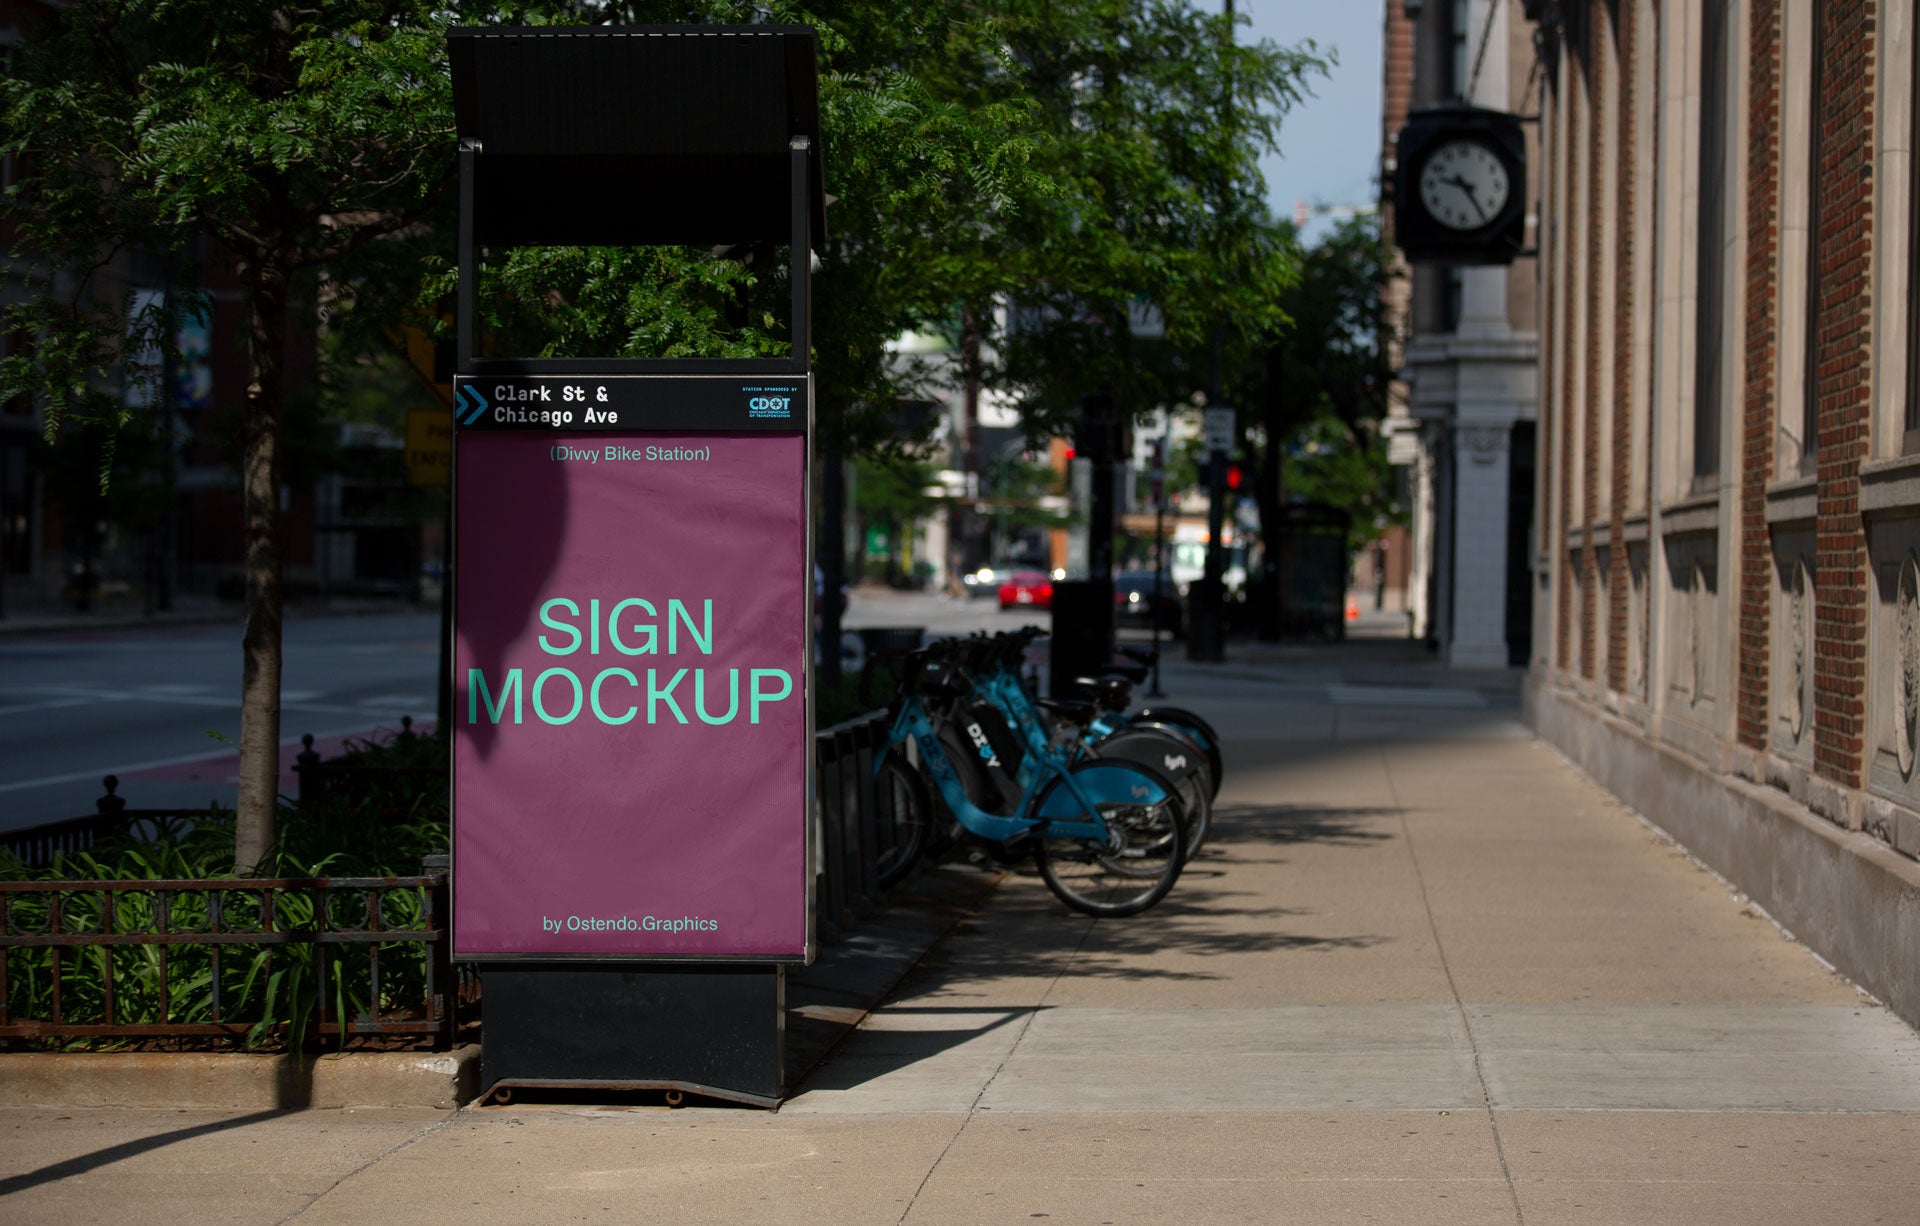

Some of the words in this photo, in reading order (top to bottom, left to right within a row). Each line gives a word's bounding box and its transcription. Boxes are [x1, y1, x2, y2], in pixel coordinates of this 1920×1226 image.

[494, 385, 551, 402] Clark
[563, 385, 585, 402] St
[596, 386, 609, 402] &
[749, 397, 791, 410] CDOT
[494, 407, 573, 427] Chicago
[584, 407, 618, 424] Ave
[549, 445, 600, 464] (Divvy
[604, 445, 641, 461] Bike
[645, 445, 711, 463] Station)
[538, 597, 713, 656] SIGN
[468, 667, 793, 725] MOCKUP
[543, 916, 563, 935] by
[567, 916, 718, 935] Ostendo.Graphics
